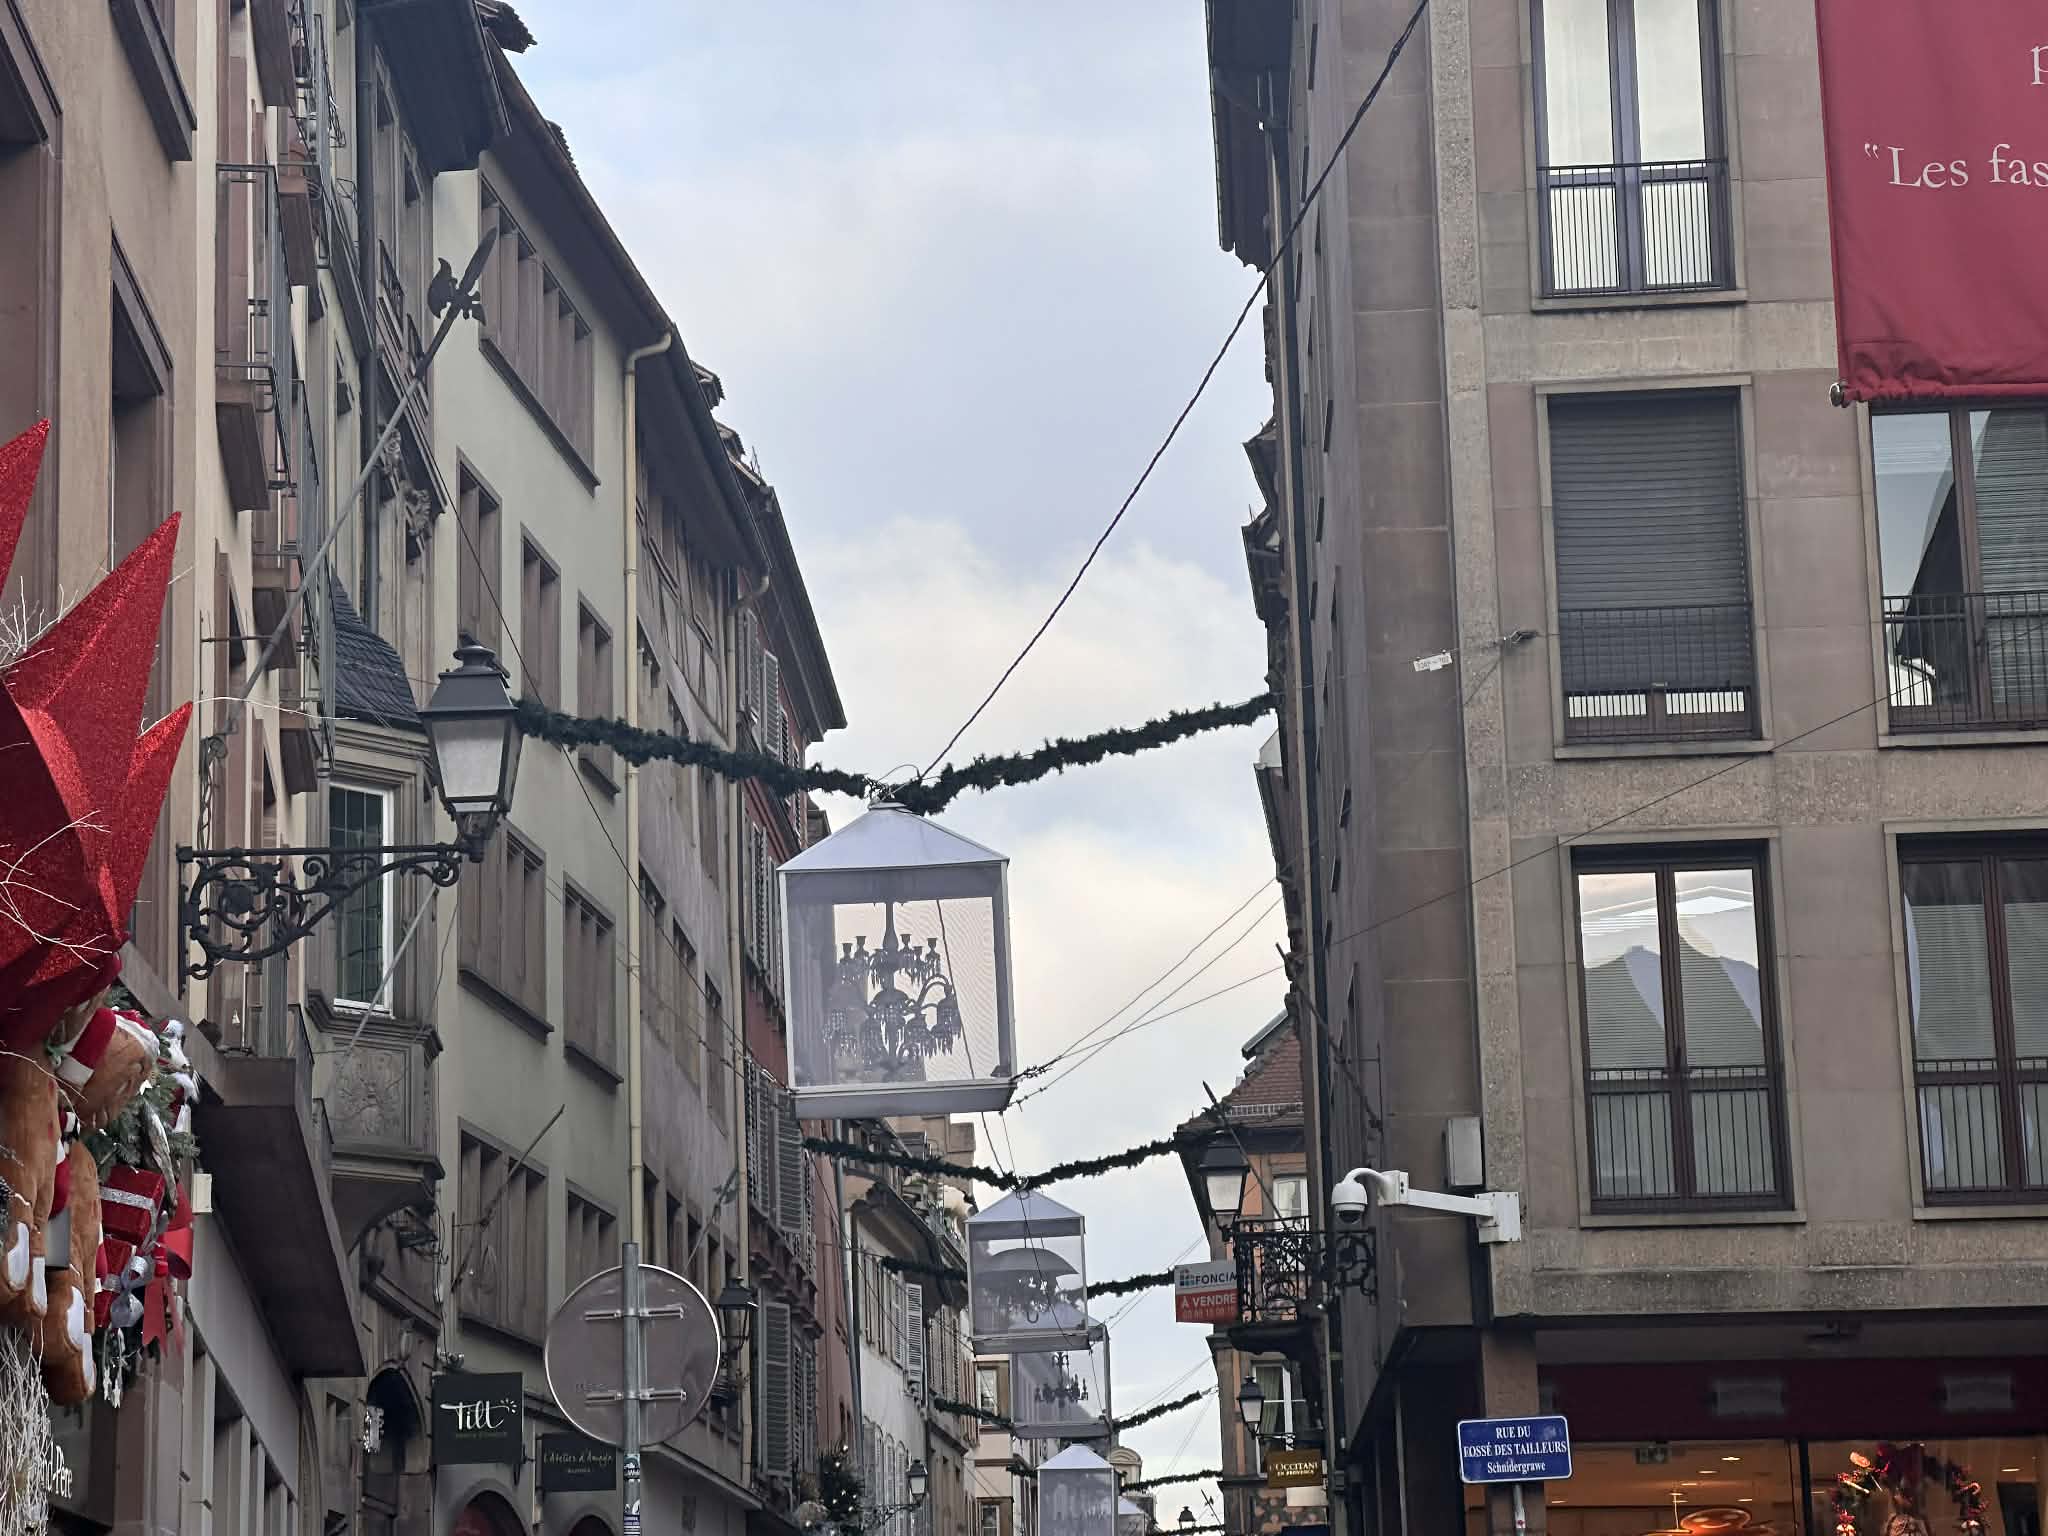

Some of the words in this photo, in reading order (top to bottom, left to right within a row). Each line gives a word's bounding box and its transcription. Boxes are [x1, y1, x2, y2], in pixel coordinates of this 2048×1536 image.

[1192, 1293, 1236, 1308] VENDRE
[1496, 1427, 1516, 1439] RUE
[1518, 1425, 1531, 1438] DU
[1463, 1442, 1493, 1458] FOSSÉ
[1495, 1444, 1513, 1456] DES
[1514, 1441, 1567, 1455] TAILLEURS
